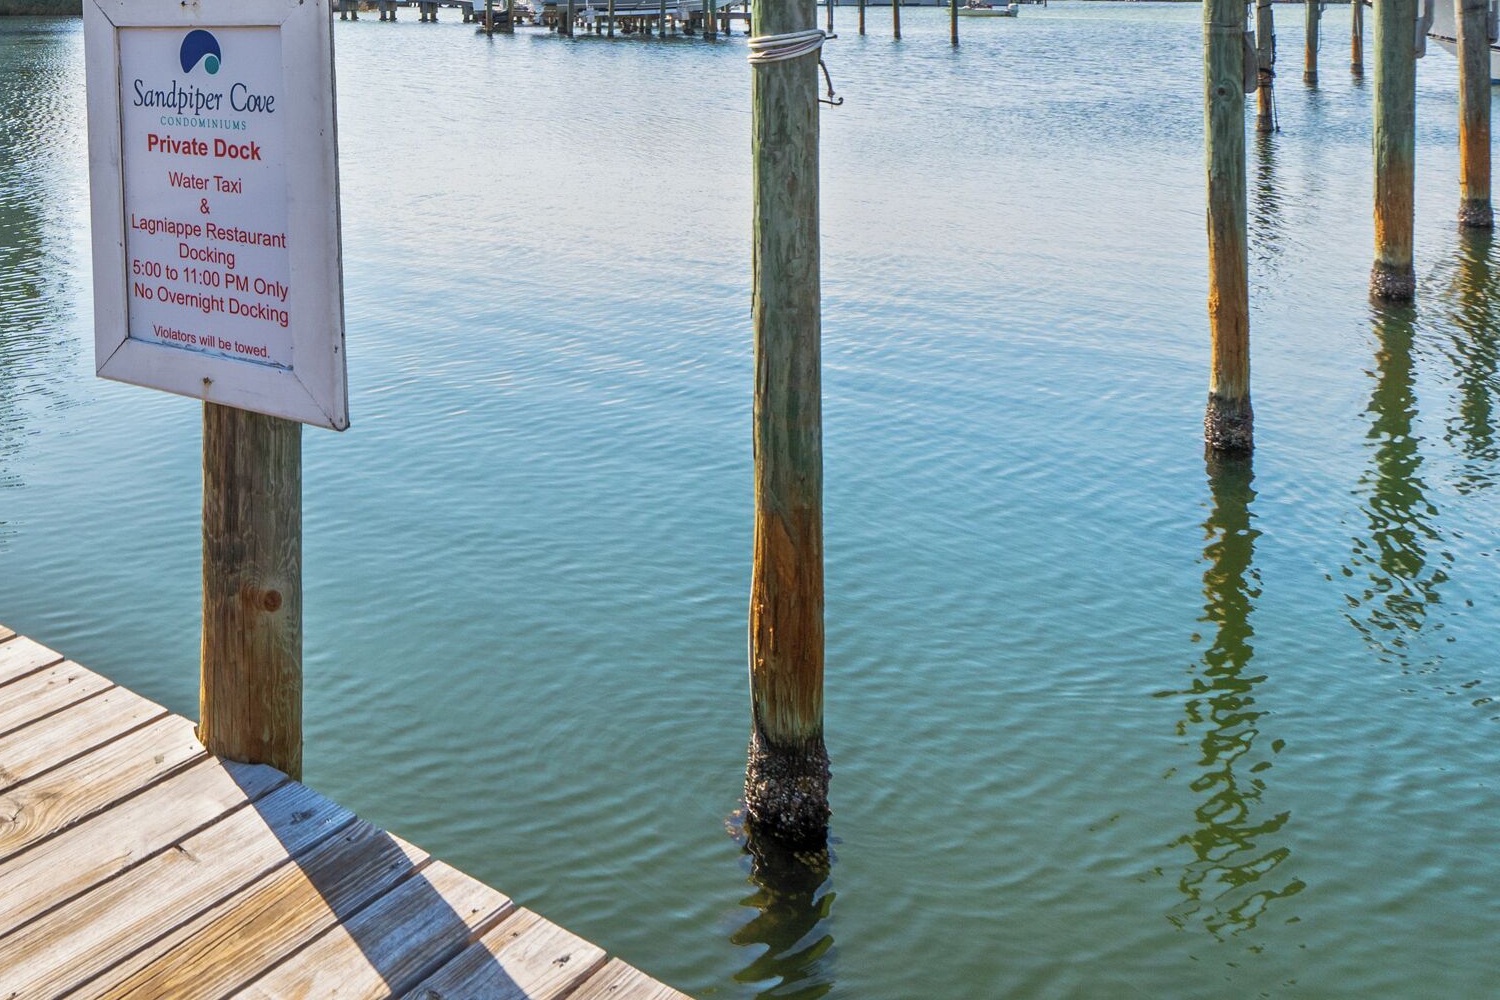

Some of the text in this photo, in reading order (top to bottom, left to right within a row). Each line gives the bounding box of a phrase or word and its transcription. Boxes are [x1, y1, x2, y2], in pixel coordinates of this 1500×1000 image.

[133, 78, 276, 116] Sandpiper Cove
[160, 115, 247, 131] CONDOMINIUMS
[147, 133, 262, 161] Private Dock
[168, 170, 242, 194] Water Taxi
[199, 197, 211, 215] &
[131, 213, 287, 249] Lagniappe Restaurant
[179, 242, 236, 270] Docking
[132, 259, 289, 303] 5:00 to 11:00 PM Only
[134, 281, 289, 328] No Overnight Docking
[153, 323, 270, 359] Violators will be towed.
